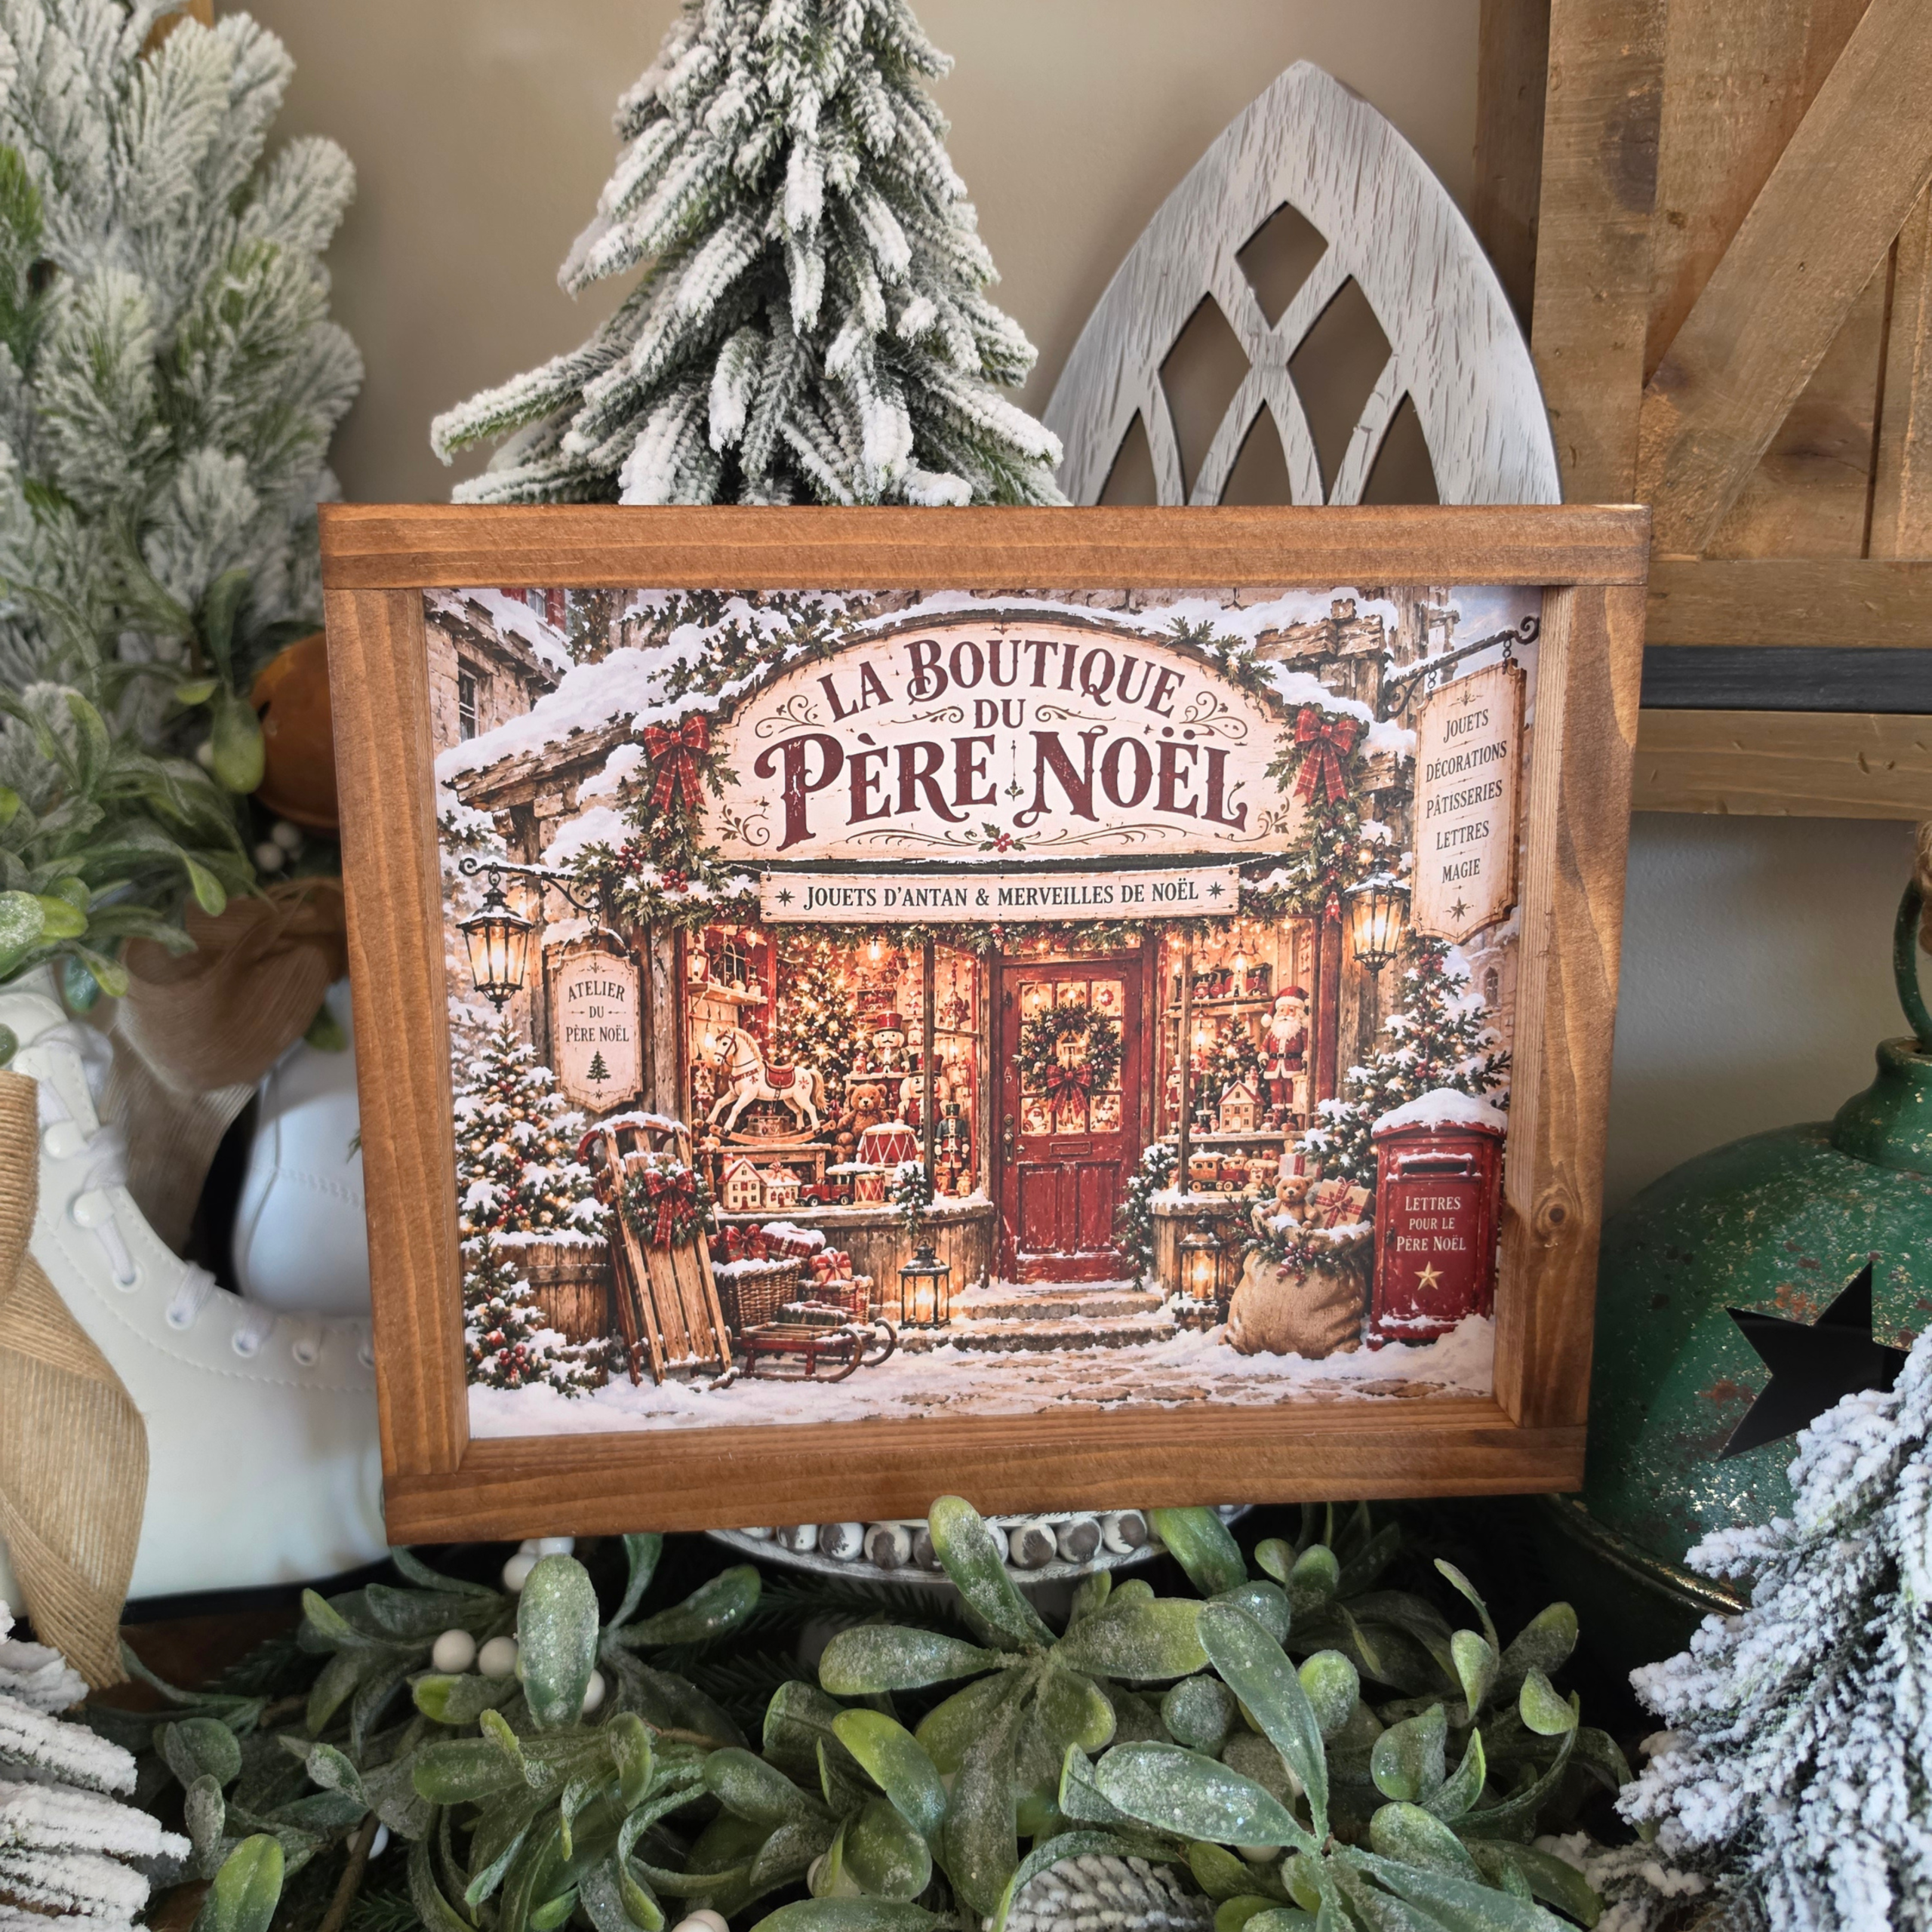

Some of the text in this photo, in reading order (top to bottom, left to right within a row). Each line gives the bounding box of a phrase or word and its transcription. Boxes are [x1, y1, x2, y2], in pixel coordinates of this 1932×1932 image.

[817, 638, 1186, 724] LA BOUTIQUE
[973, 698, 1027, 730] DU
[1443, 709, 1489, 743] JOUETS
[1425, 740, 1507, 783] DÉCORATIONS
[755, 724, 1249, 852] PÈRE NOËL
[1425, 779, 1503, 819] PÂTISSERIES
[1435, 820, 1490, 851] LETTRES
[1441, 858, 1481, 884] MAGIE
[803, 886, 877, 911] JOUETS
[975, 888, 990, 906] &
[997, 884, 1114, 906] MERVEILLES
[1121, 884, 1145, 903] DE
[1152, 878, 1199, 902] NOËL
[568, 980, 626, 1003] ATELIER
[589, 1005, 605, 1018] DU
[565, 1024, 629, 1043] PÈRE NOËL
[1404, 1195, 1461, 1211] LETTRES
[1408, 1217, 1456, 1230] POUR LE
[1432, 1234, 1466, 1251] NOËL
